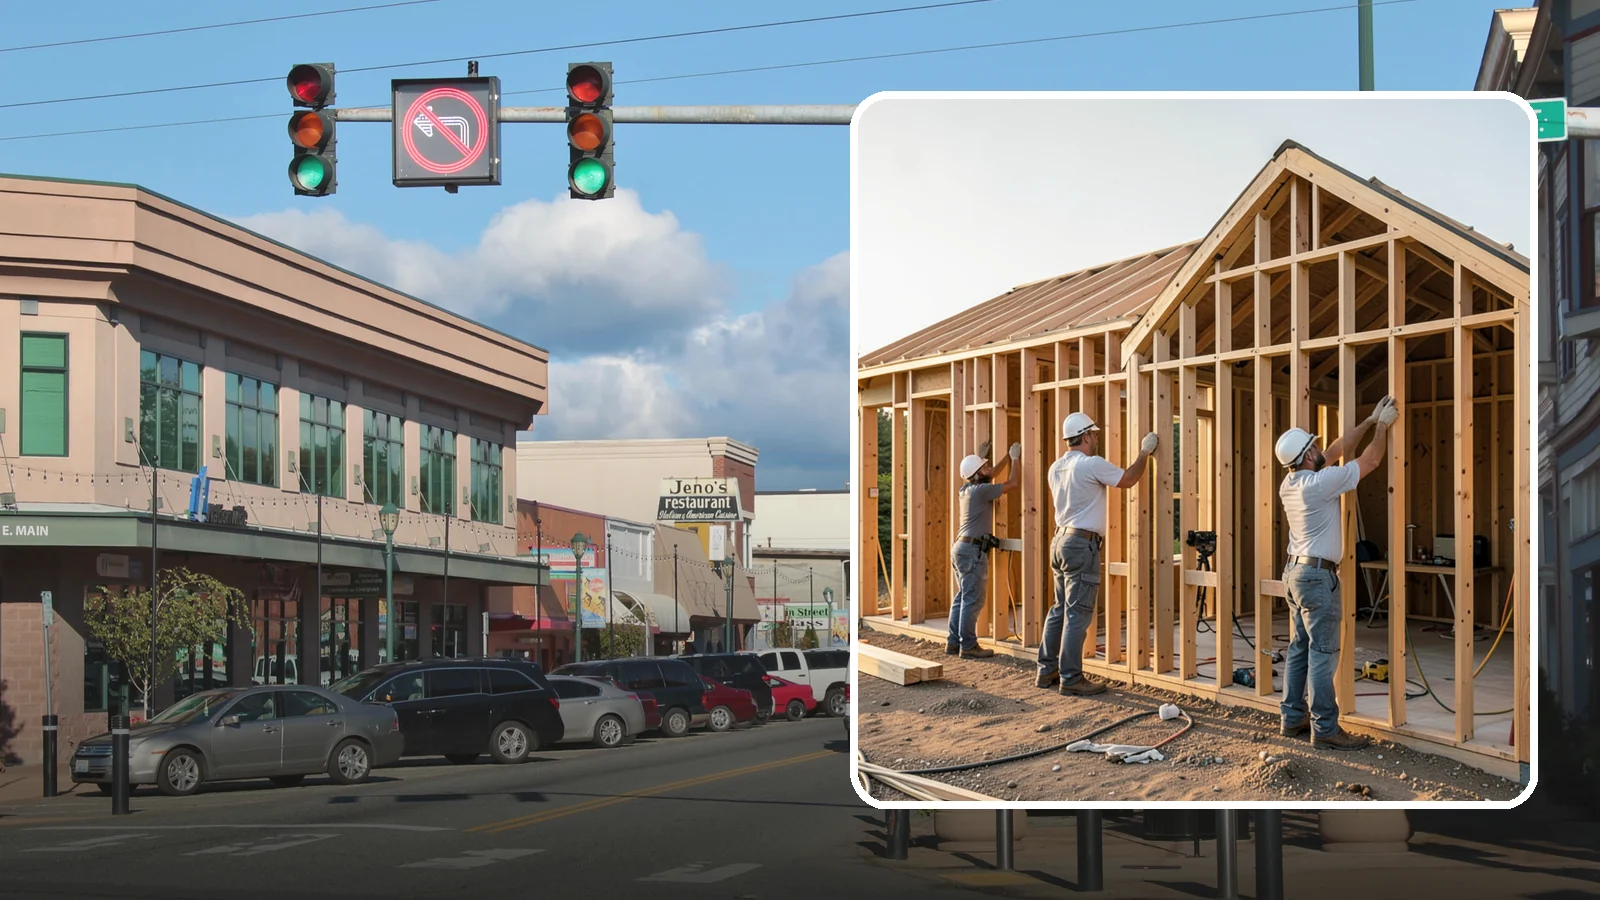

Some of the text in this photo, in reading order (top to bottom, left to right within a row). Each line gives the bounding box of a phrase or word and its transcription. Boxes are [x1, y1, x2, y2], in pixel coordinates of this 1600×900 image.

[669, 480, 728, 495] Jeno's
[665, 496, 731, 509] restaurant
[686, 509, 714, 519] American
[715, 509, 738, 519] Cuisine
[2, 525, 49, 536] E. MAIN
[797, 607, 828, 617] Street
